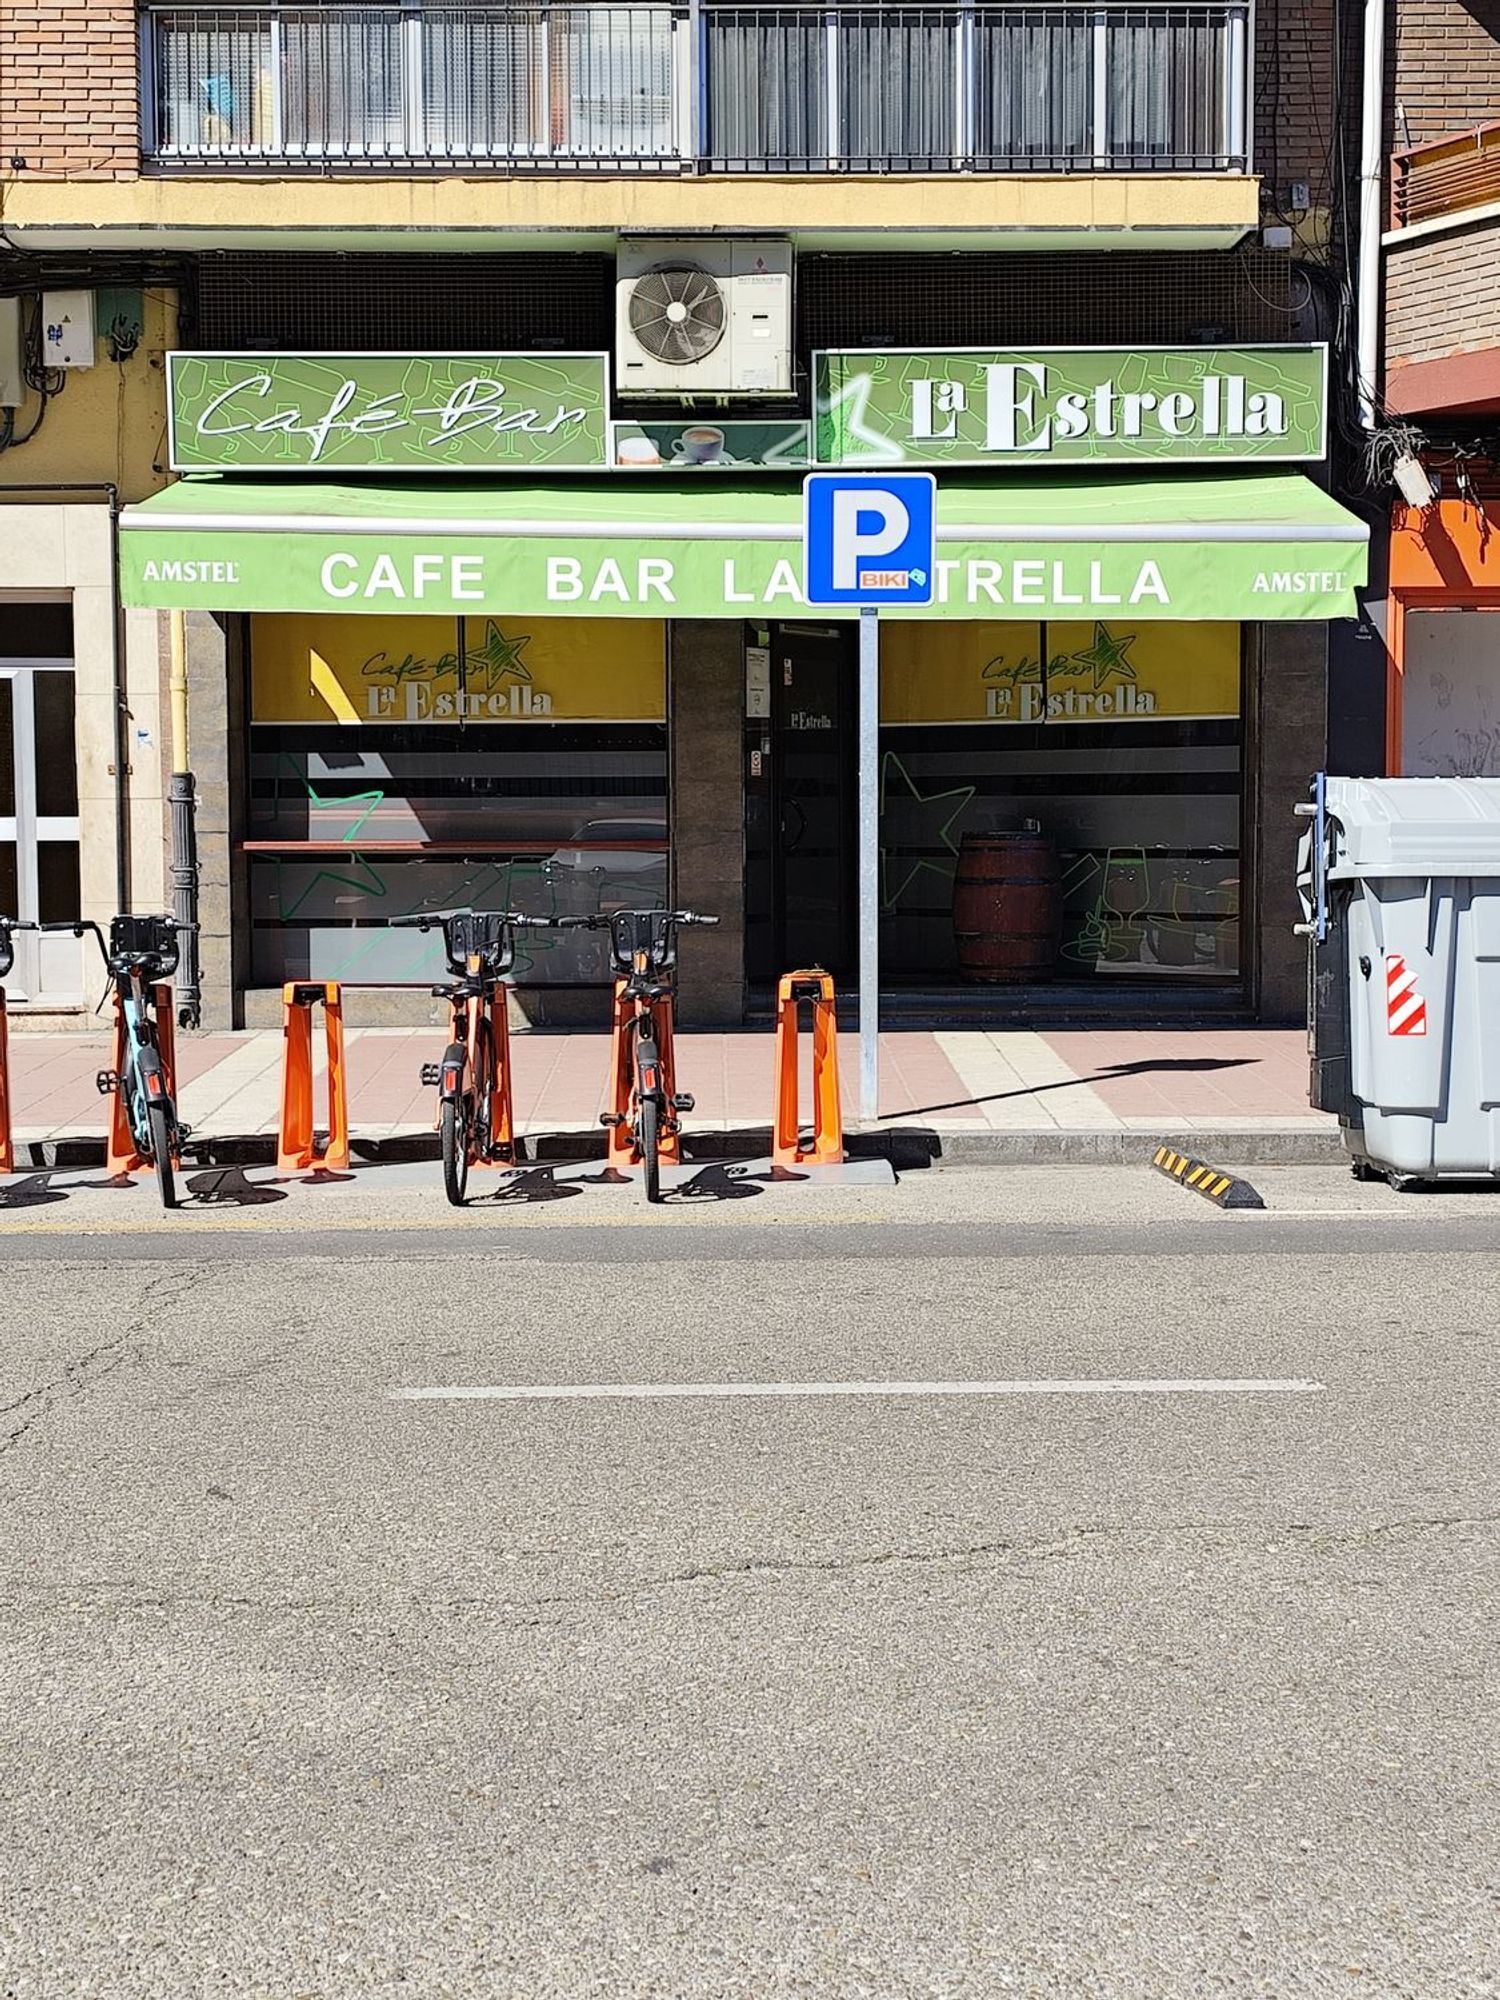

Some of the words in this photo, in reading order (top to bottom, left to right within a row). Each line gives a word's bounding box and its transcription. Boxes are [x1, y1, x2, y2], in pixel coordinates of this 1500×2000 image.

[197, 374, 410, 461] Café
[411, 376, 588, 446] Bar
[906, 378, 969, 440] La
[976, 362, 1290, 452] Estrella
[832, 489, 911, 590] P
[142, 560, 240, 583] AMSTEL
[320, 552, 486, 600] CAFE
[545, 556, 677, 603] BAR
[723, 558, 804, 603] LA
[935, 559, 1171, 604] TRELLA
[861, 572, 906, 588] BIKI
[1252, 571, 1347, 593] AMSTEL
[361, 652, 427, 684] Café
[981, 656, 1041, 687] Café
[1046, 654, 1094, 680] Bar
[367, 684, 396, 716] La
[400, 679, 555, 721] Estrella
[985, 686, 1013, 718] La
[1017, 681, 1158, 721] Estrella
